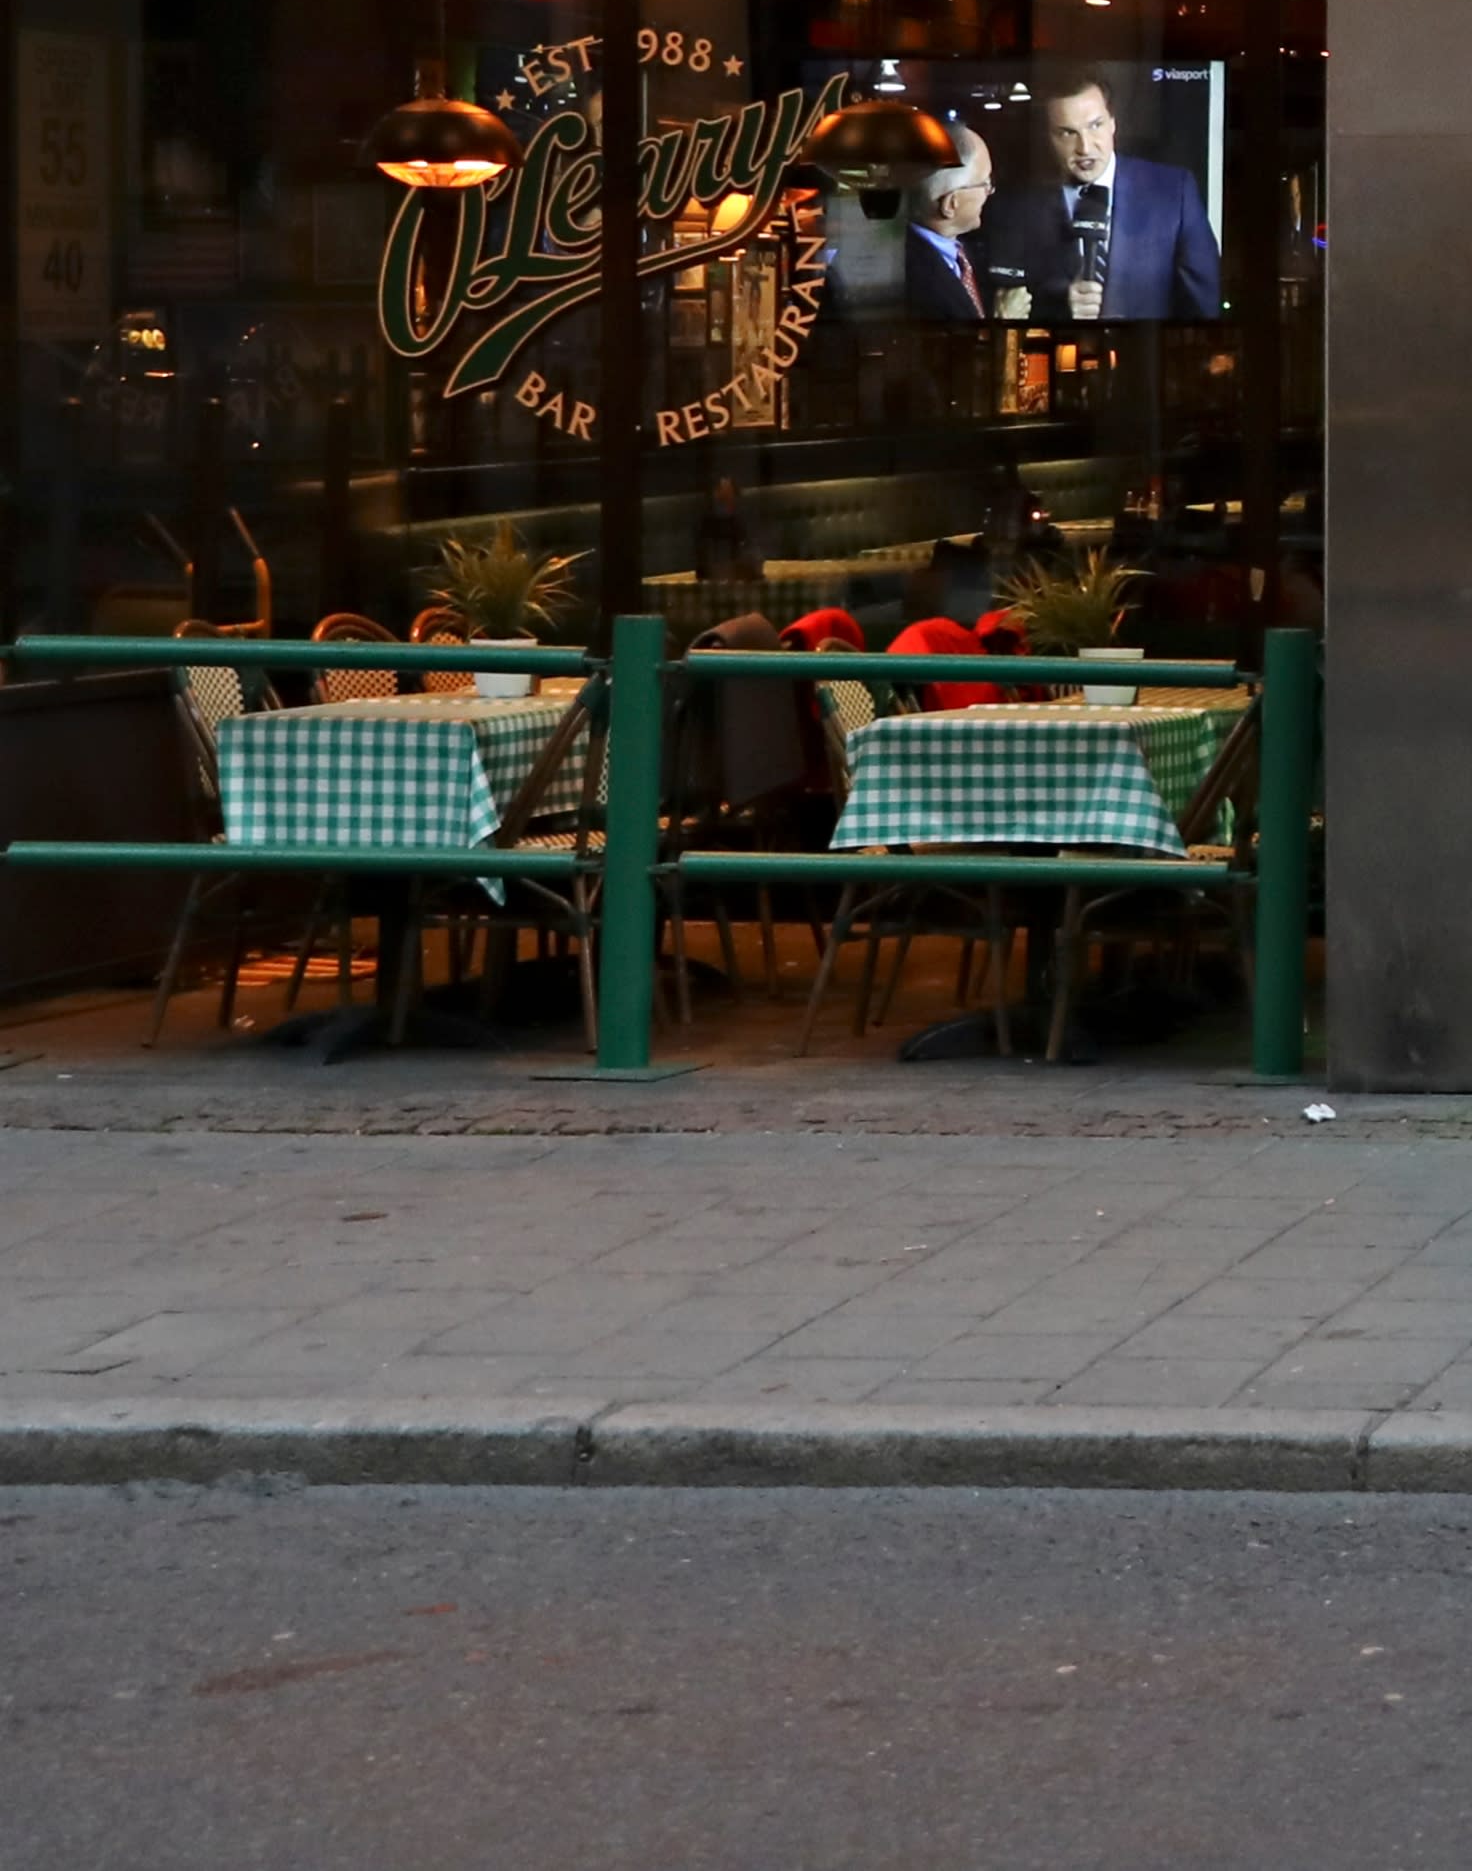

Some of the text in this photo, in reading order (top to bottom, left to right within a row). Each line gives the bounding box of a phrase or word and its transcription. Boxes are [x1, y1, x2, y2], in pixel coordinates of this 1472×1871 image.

[522, 28, 713, 96] EST 988
[514, 371, 597, 442] BAR
